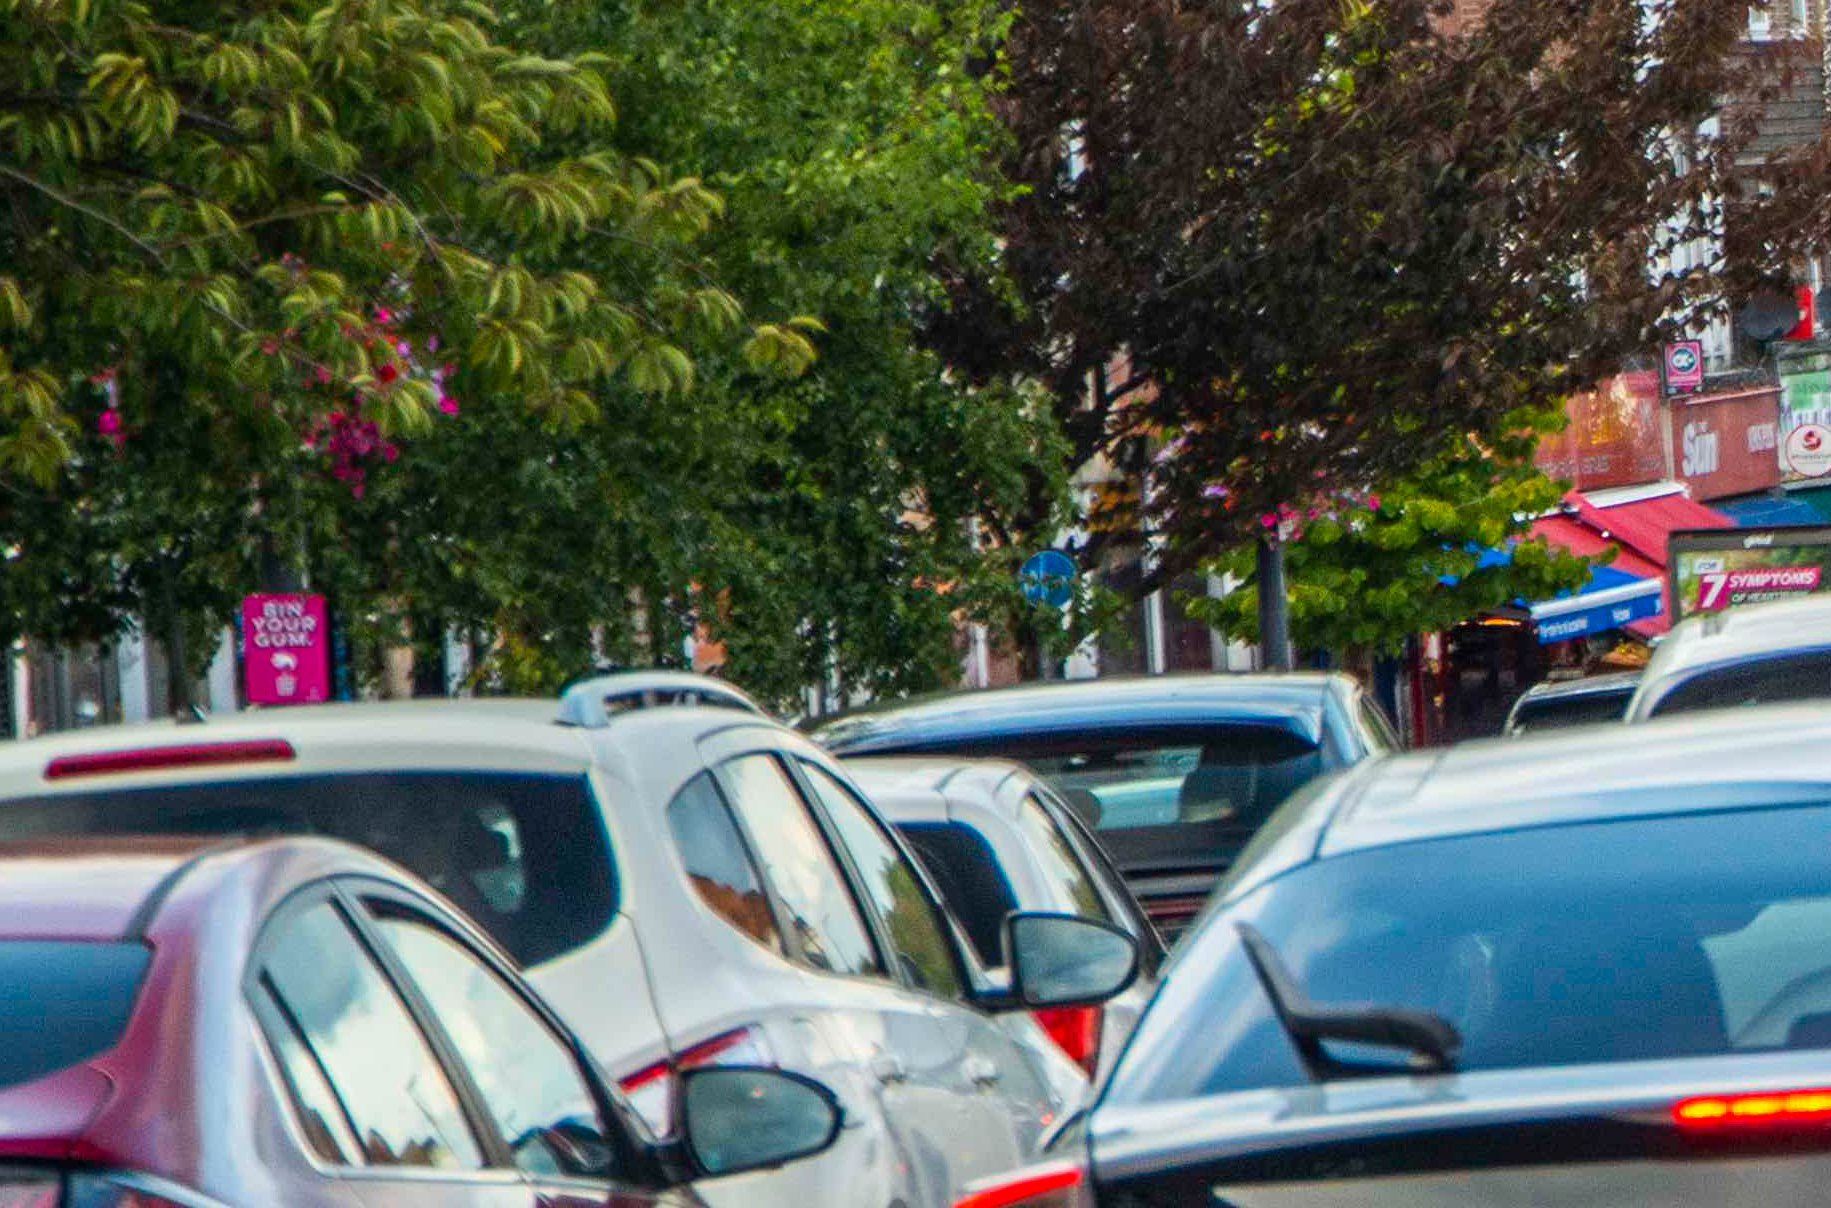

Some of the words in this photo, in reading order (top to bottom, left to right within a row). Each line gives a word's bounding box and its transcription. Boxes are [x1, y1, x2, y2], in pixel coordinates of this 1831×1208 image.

[1729, 571, 1815, 588] SYMPTOMS
[1702, 573, 1726, 608] 7
[264, 601, 302, 616] BIN
[252, 616, 316, 632] YOUR
